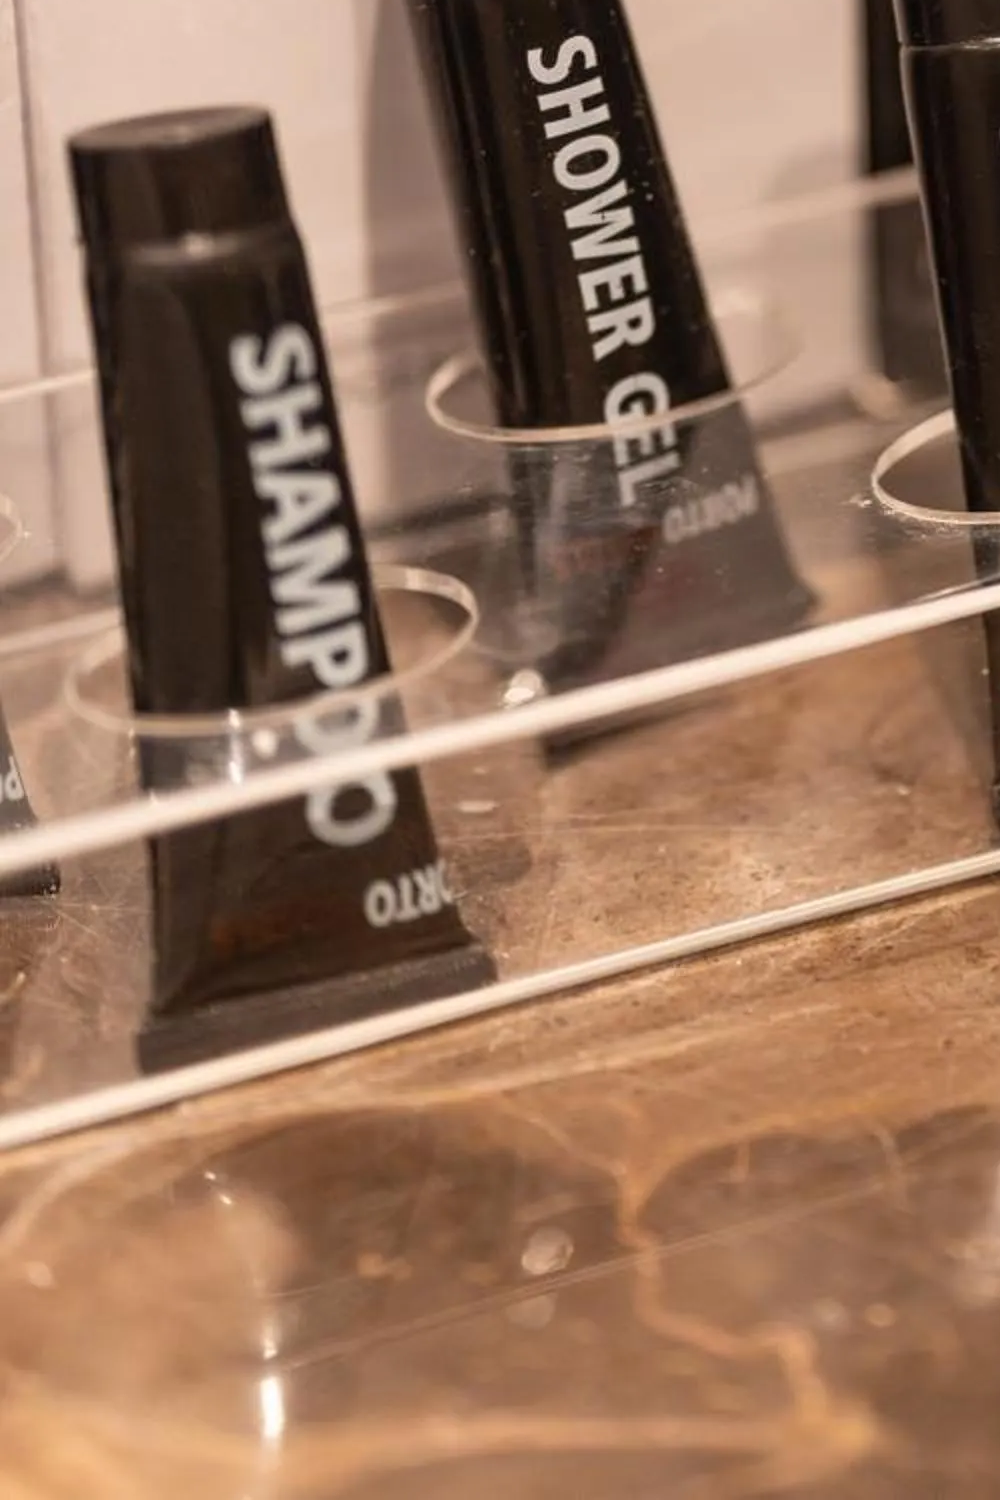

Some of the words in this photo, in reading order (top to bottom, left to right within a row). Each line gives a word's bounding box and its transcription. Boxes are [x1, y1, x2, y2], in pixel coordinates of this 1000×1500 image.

[526, 34, 656, 362] SHOWER
[604, 371, 682, 508] GEL
[229, 322, 399, 847] SHAMPOO
